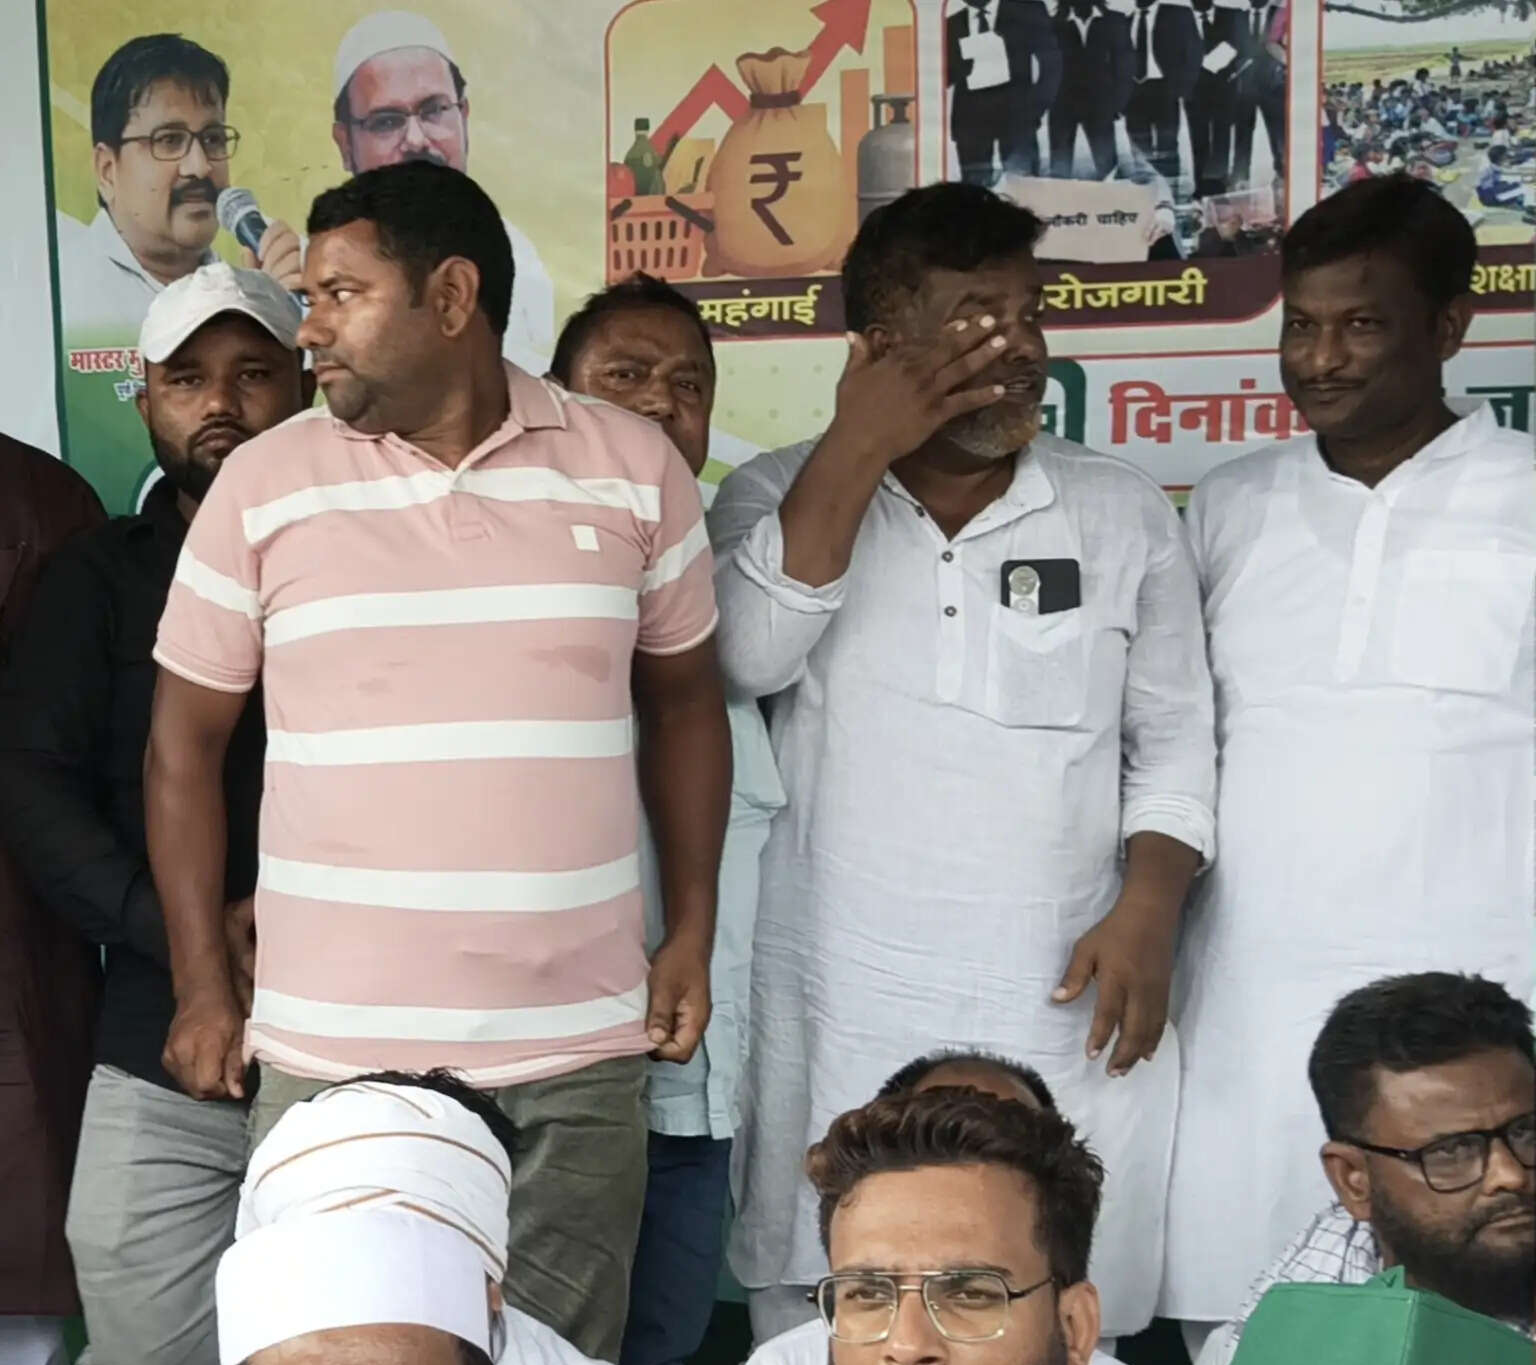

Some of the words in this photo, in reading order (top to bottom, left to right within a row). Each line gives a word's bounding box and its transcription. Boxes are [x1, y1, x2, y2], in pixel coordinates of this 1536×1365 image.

[1037, 266, 1208, 311] रोजगारी
[1469, 262, 1536, 294] शक्षा
[697, 284, 823, 327] महंगाई
[69, 348, 126, 373] मास्टर
